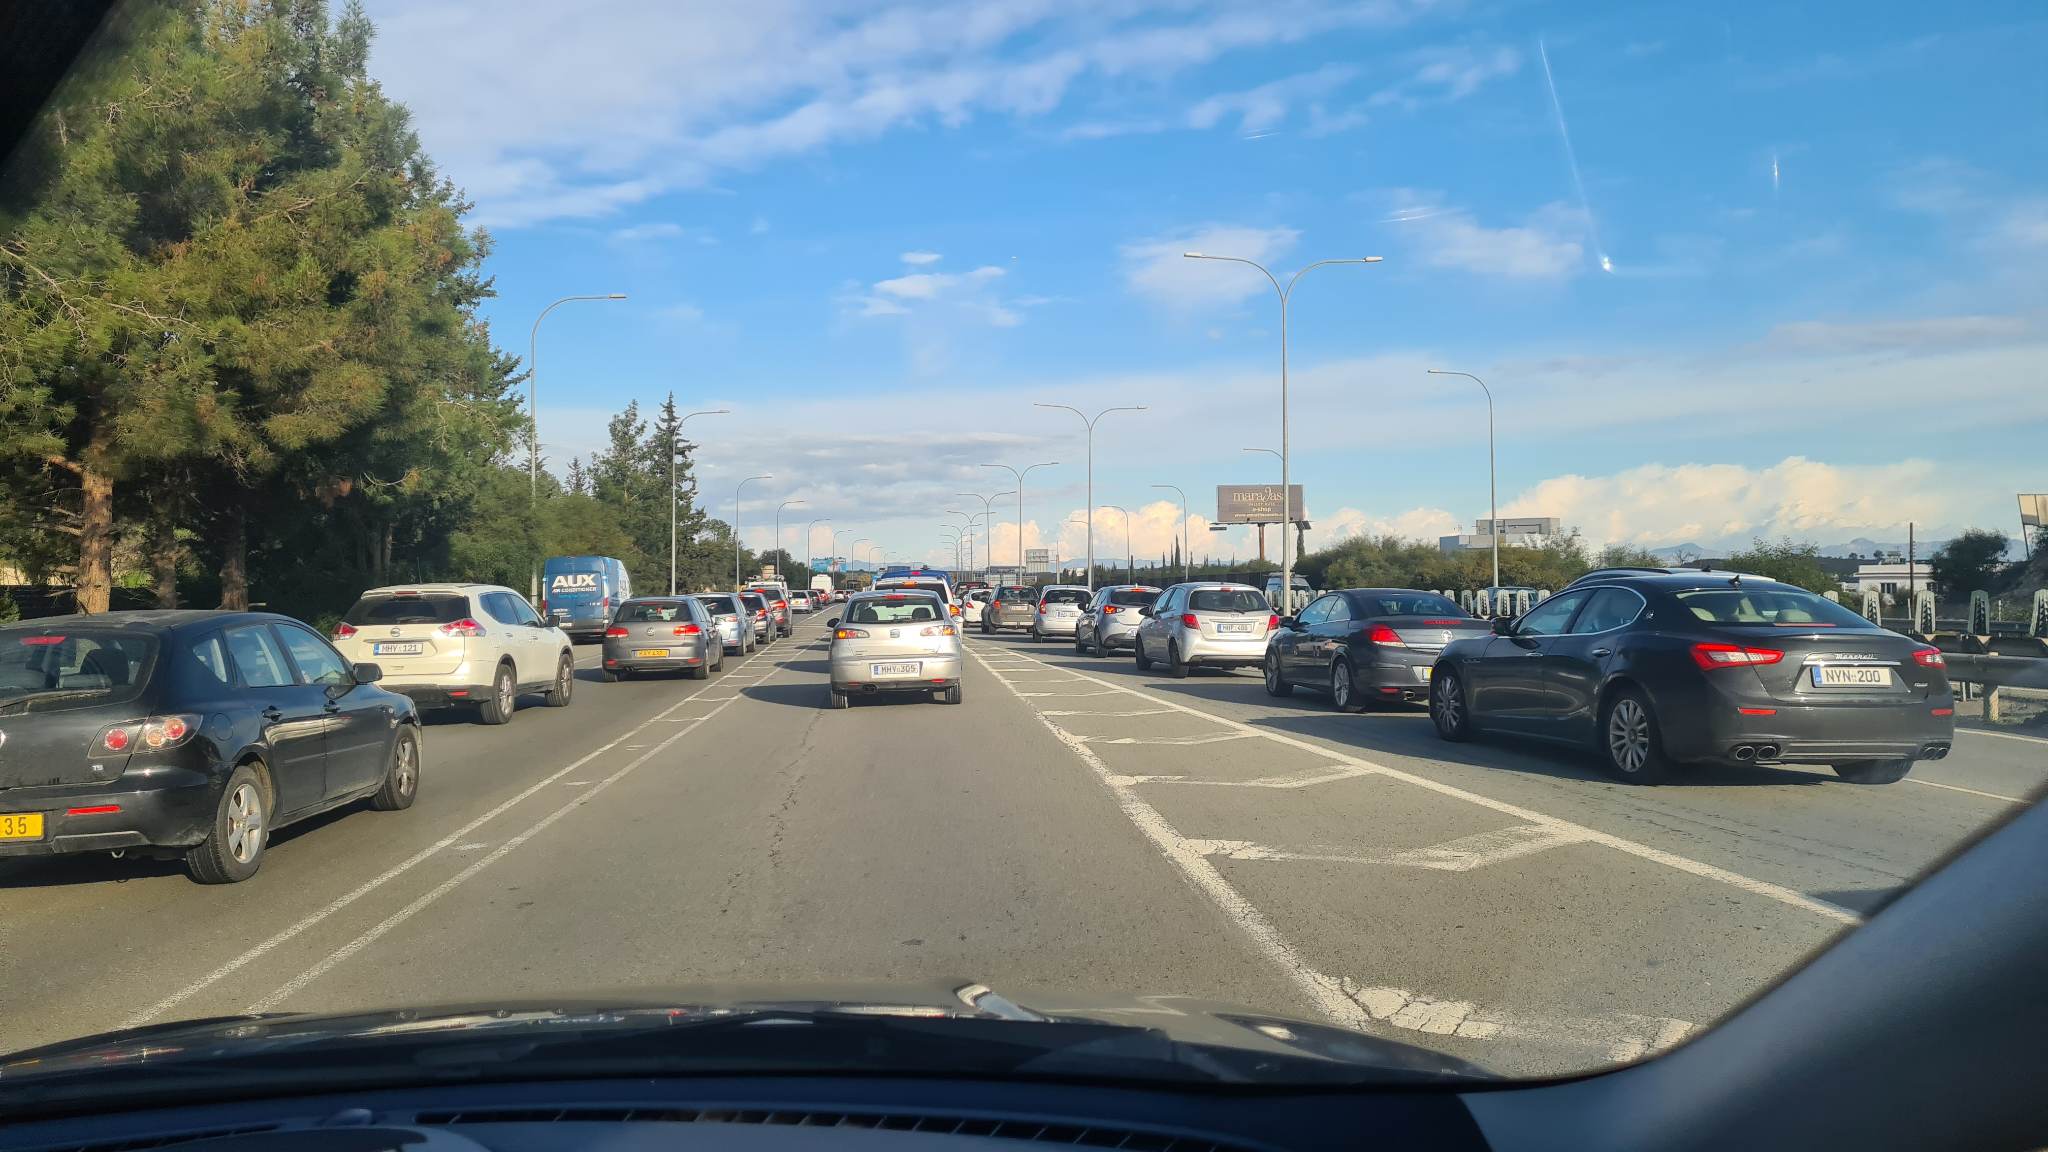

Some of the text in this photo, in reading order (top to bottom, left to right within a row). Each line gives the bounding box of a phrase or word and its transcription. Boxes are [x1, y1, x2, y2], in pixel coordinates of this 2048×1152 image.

[552, 574, 597, 588] AUX
[403, 644, 417, 652] 121
[900, 664, 916, 673] 305
[1826, 669, 1881, 683] NYN 200
